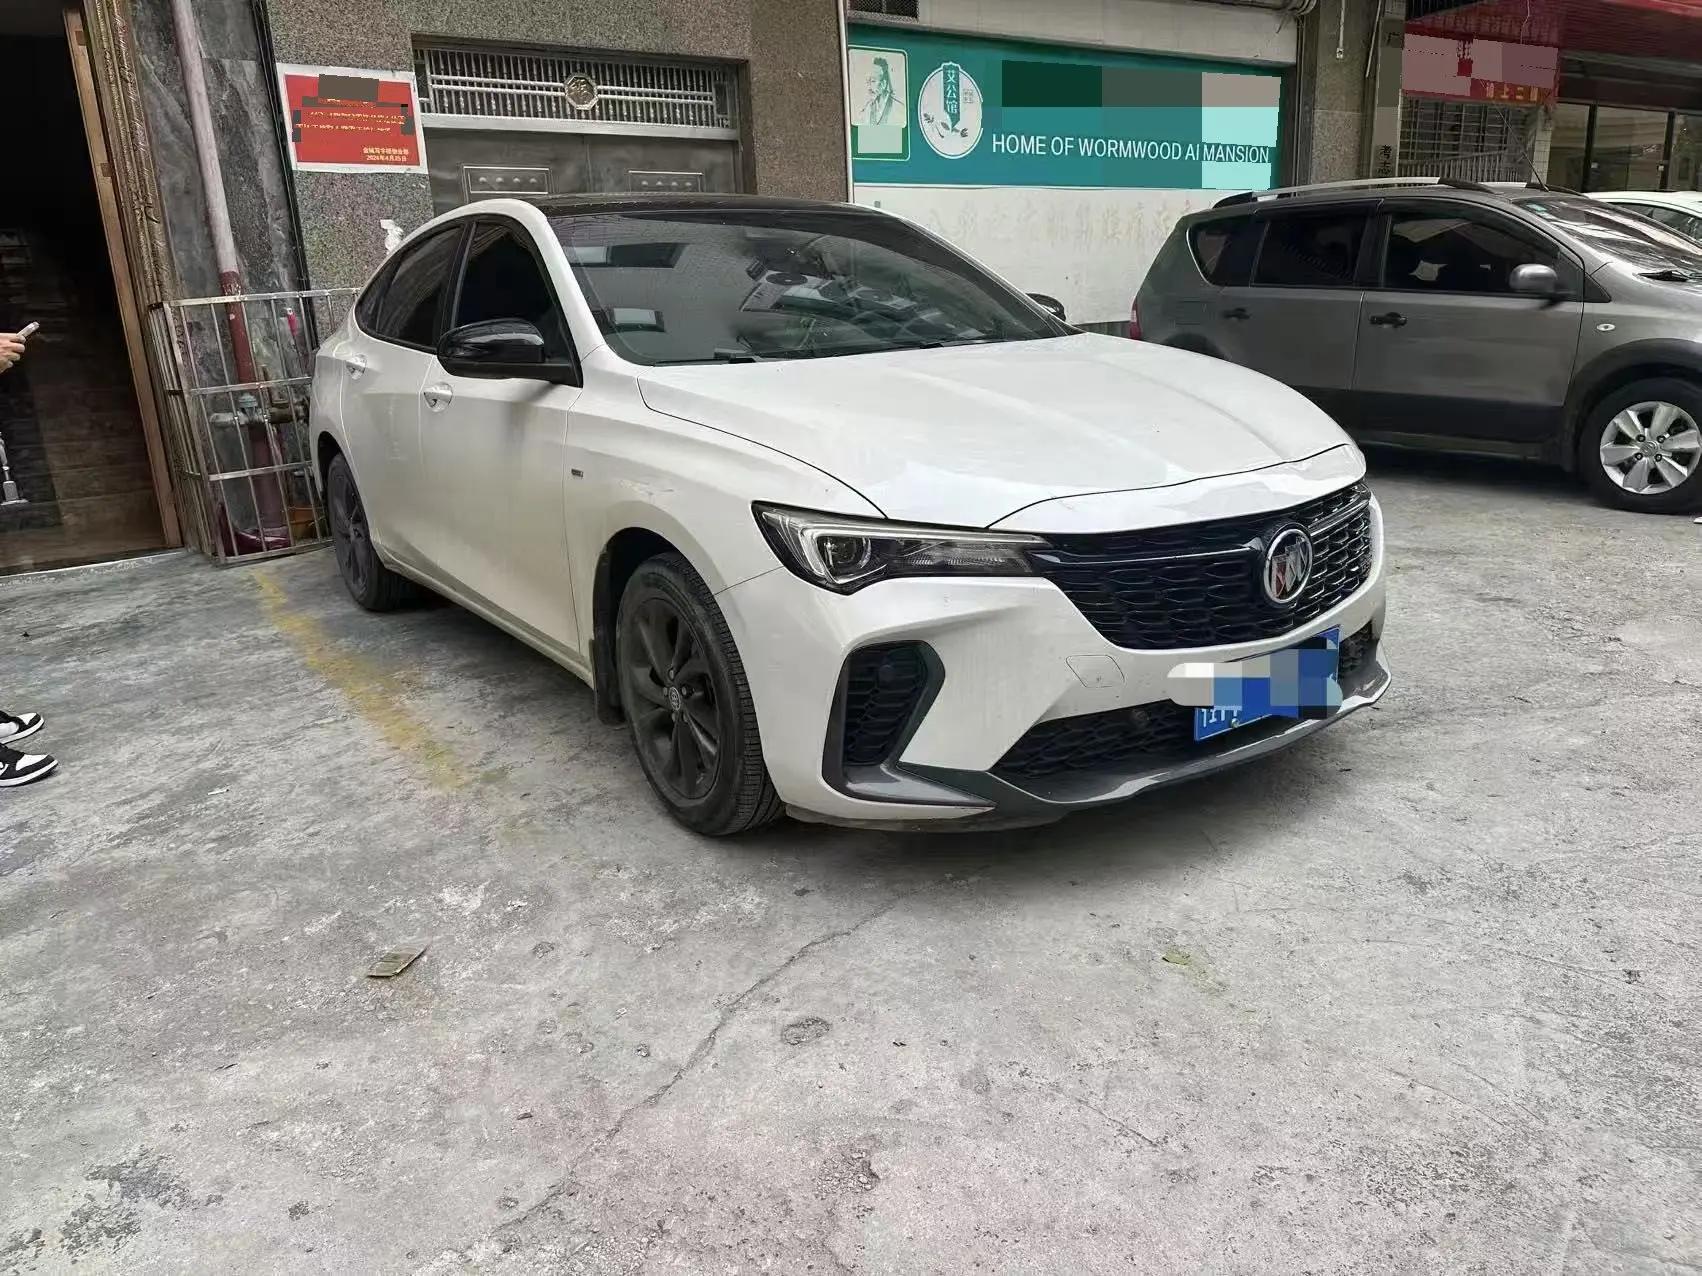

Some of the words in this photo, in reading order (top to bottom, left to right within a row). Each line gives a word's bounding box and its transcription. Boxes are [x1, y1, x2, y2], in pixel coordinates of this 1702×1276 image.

[946, 69, 958, 113] 艾公馆
[992, 133, 1047, 155] HOME
[1051, 136, 1075, 156] OF
[1078, 137, 1182, 160] WORMWOOD
[1185, 143, 1200, 161] AI
[1203, 144, 1269, 163] MANSION
